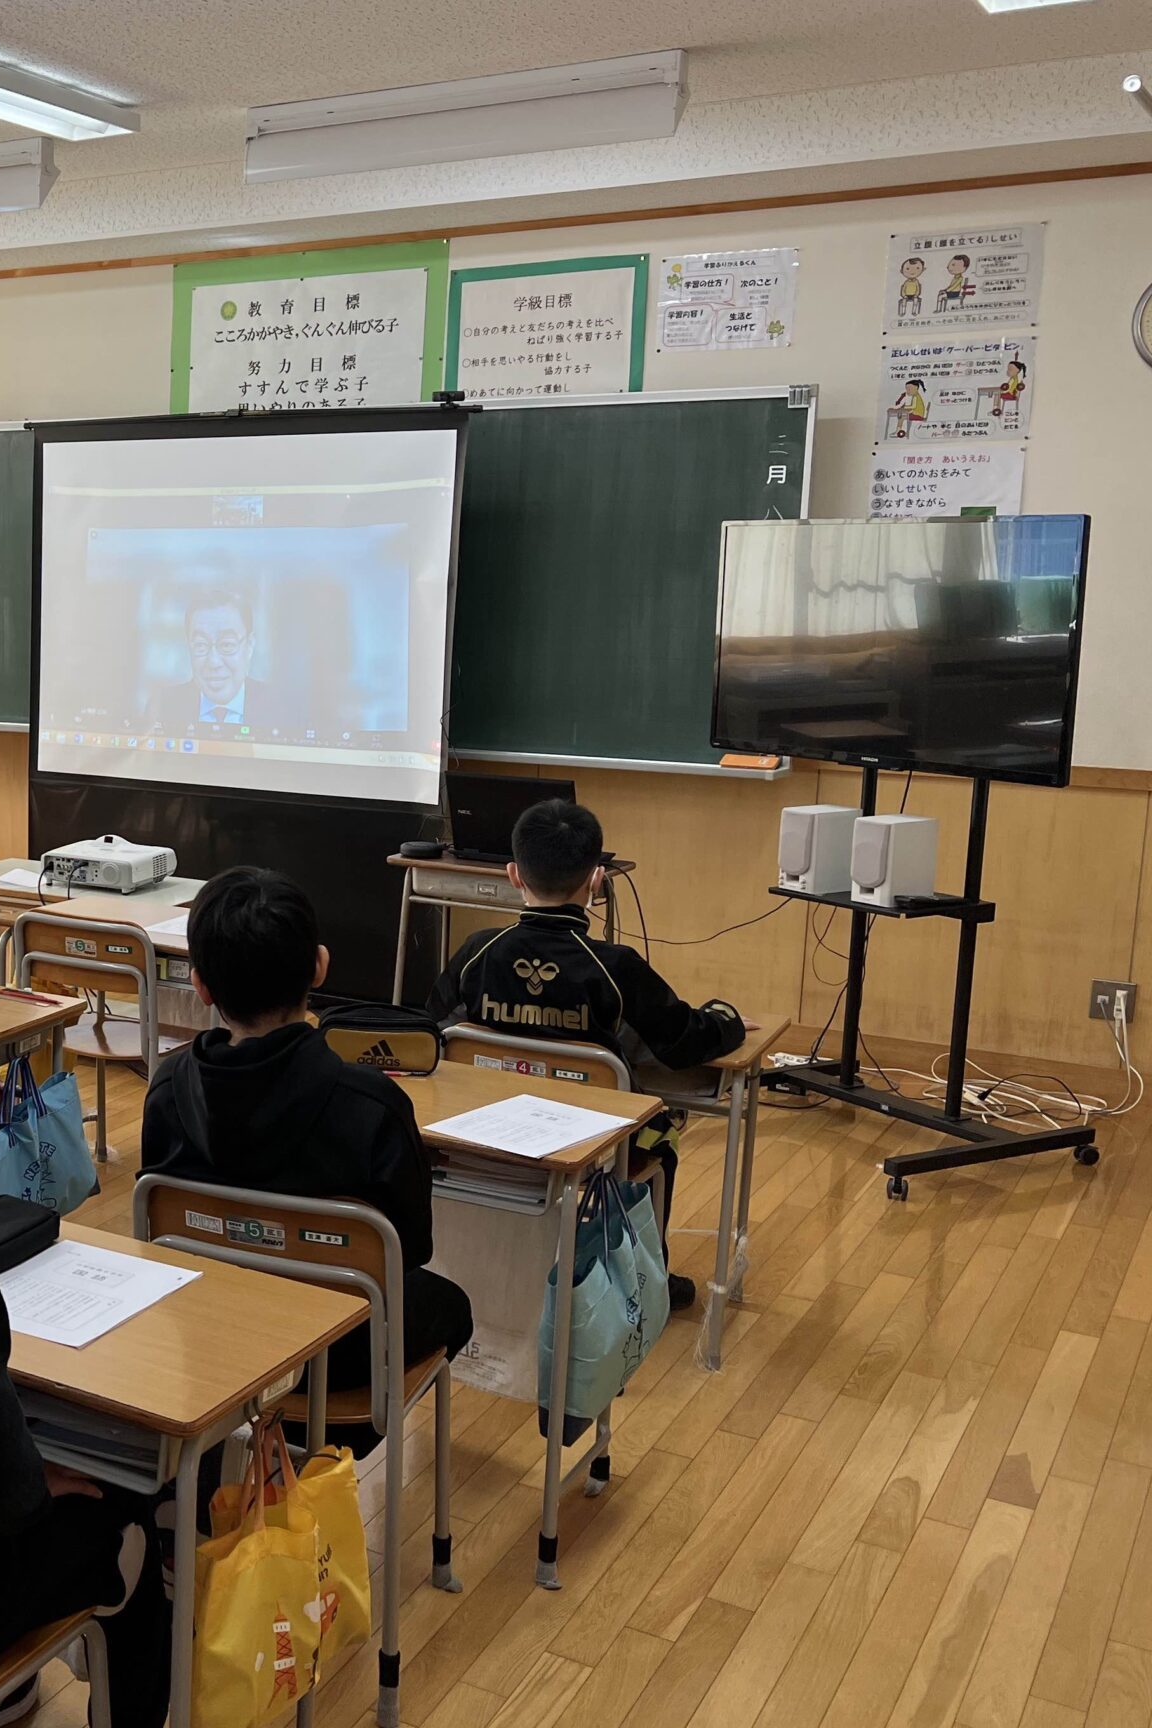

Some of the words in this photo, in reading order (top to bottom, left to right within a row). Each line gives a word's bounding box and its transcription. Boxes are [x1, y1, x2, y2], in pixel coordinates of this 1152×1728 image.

[248, 293, 360, 317] 教育目標
[513, 293, 573, 311] 学級目標
[729, 312, 753, 320] 生活と
[725, 323, 757, 332] つなげて
[248, 355, 357, 376] 努力目標
[544, 364, 592, 376] 協力する子
[238, 376, 369, 397] すすんで学ぶ子
[876, 468, 972, 479] あいてのかおをみて
[874, 484, 937, 493] いいしせいで
[873, 498, 947, 508] うなずきながら
[482, 993, 588, 1031] hummel
[357, 1056, 400, 1067] adidas
[250, 1222, 259, 1237] 5
